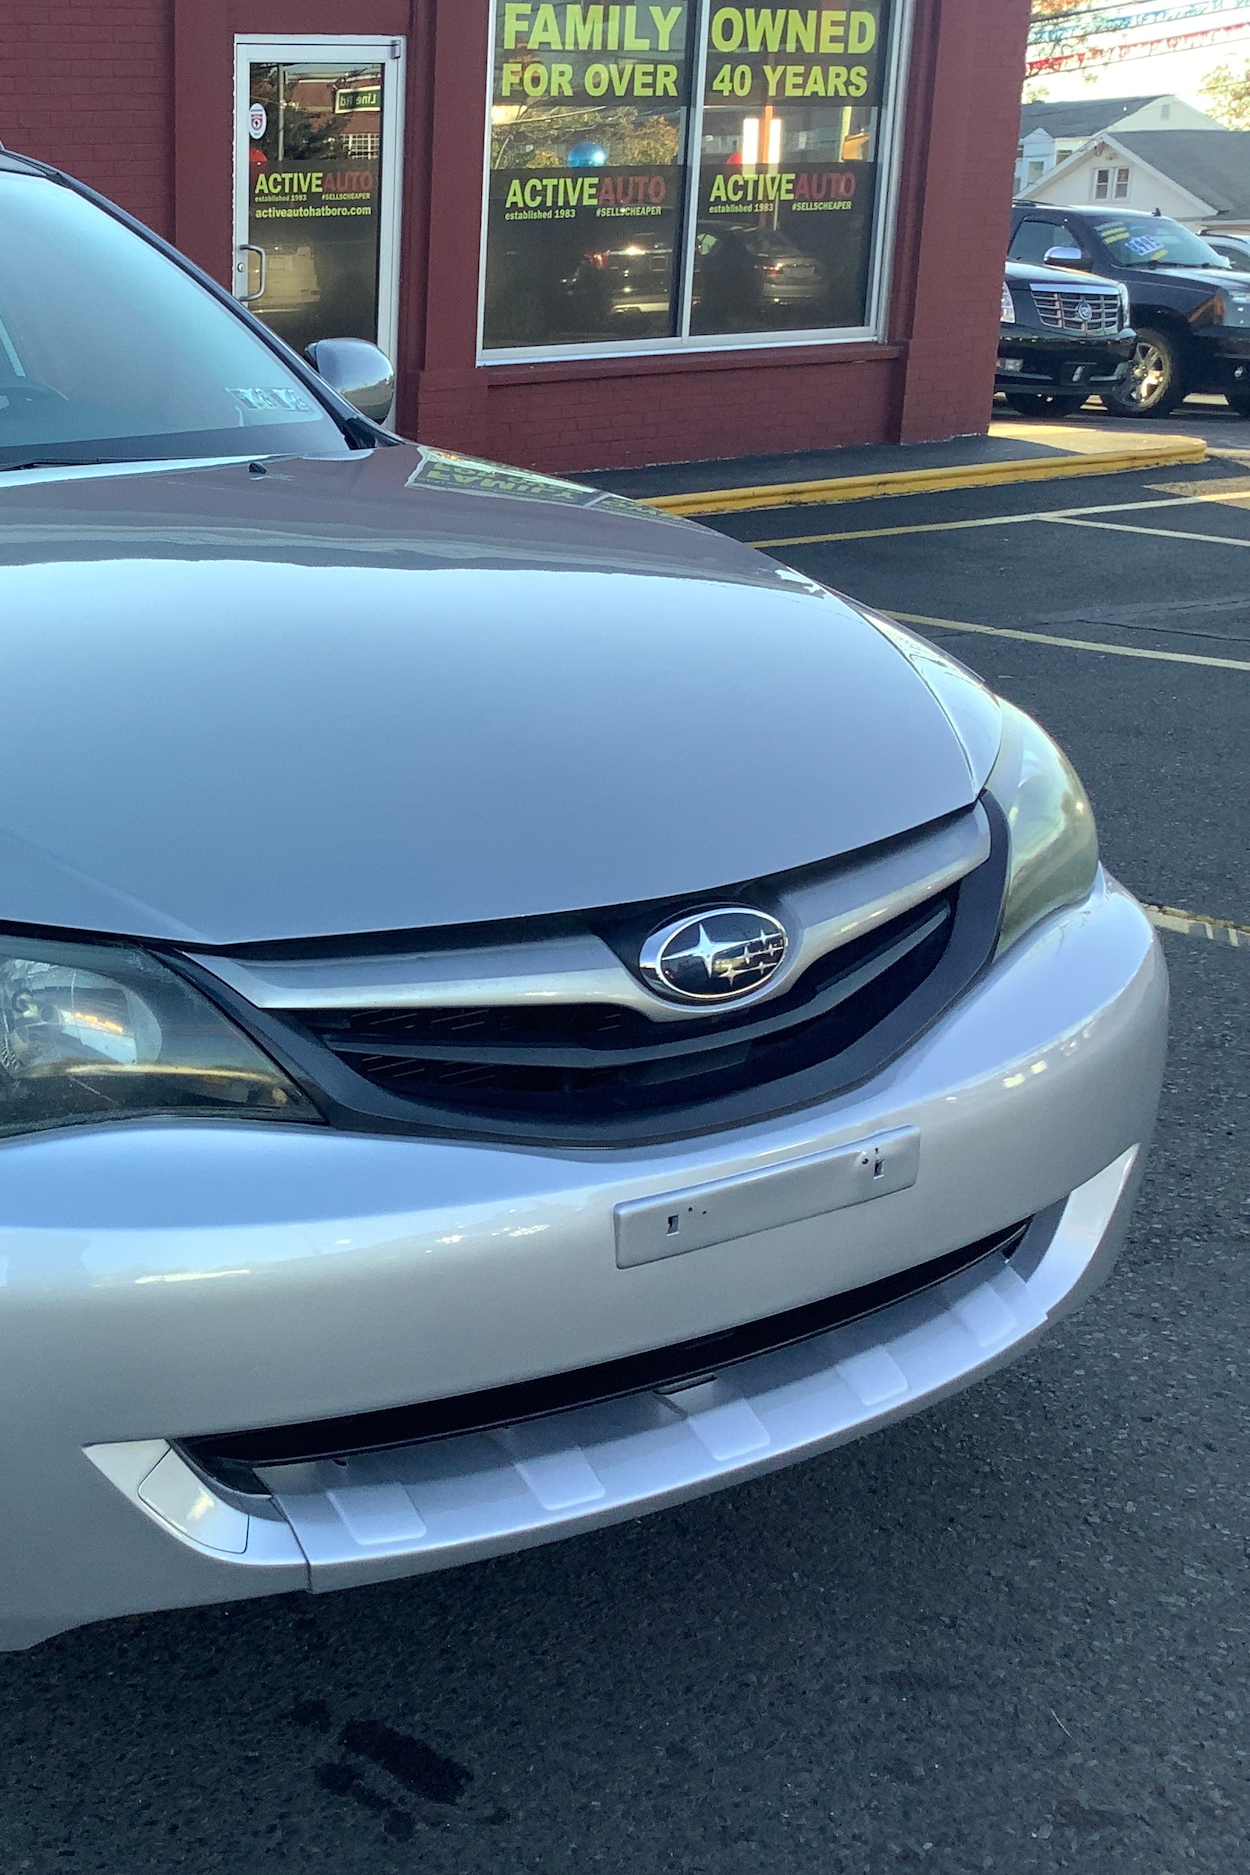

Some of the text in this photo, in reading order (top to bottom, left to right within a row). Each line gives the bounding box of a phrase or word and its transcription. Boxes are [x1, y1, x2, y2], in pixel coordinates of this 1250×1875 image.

[503, 3, 876, 54] FAMILY OWNED
[502, 63, 868, 98] FOR OVER 40 YEARS
[255, 195, 290, 203] established
[596, 206, 662, 217] #SELLSCHEAPER
[709, 203, 774, 214] established 1983
[792, 201, 852, 212] #SELLSCHEAPER
[255, 206, 372, 219] activeautohatboro.com
[505, 209, 576, 221] established 1983
